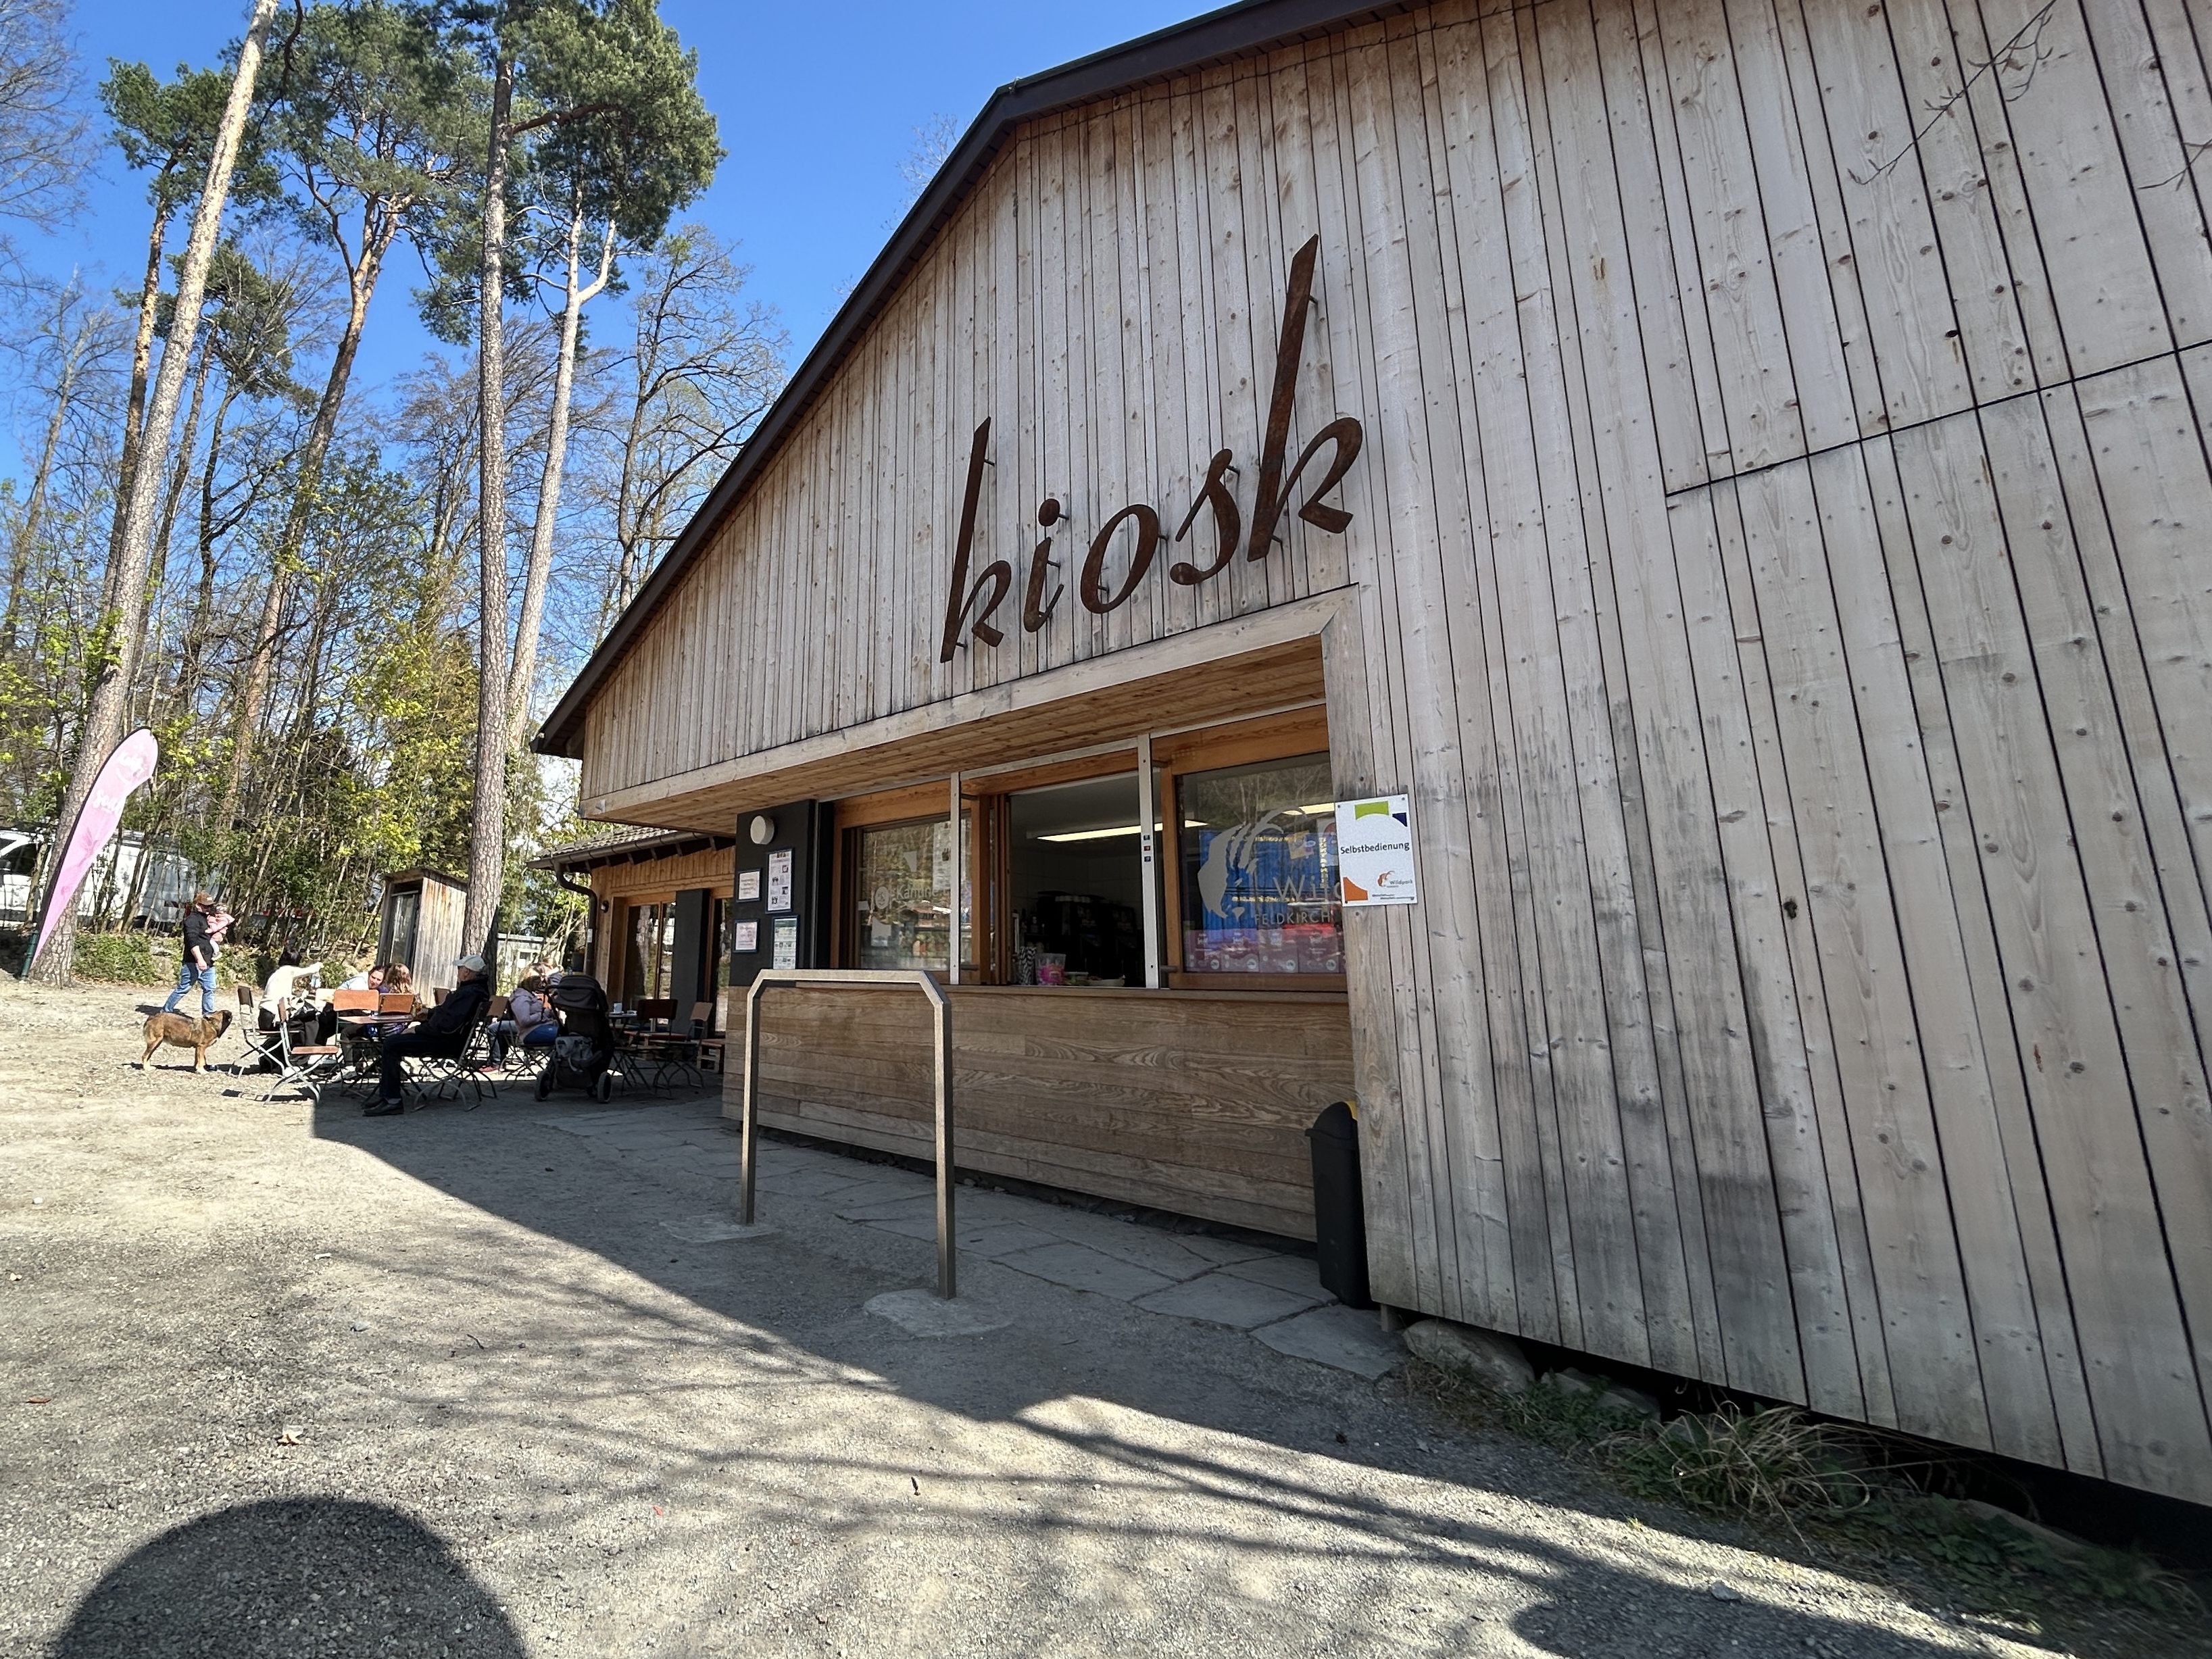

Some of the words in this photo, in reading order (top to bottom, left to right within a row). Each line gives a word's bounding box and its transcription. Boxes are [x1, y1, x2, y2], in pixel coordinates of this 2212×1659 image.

[940, 234, 1362, 663] kiosk
[1340, 842, 1410, 854] Selbstbedienung
[1254, 911, 1331, 926] FELDKIRCH
